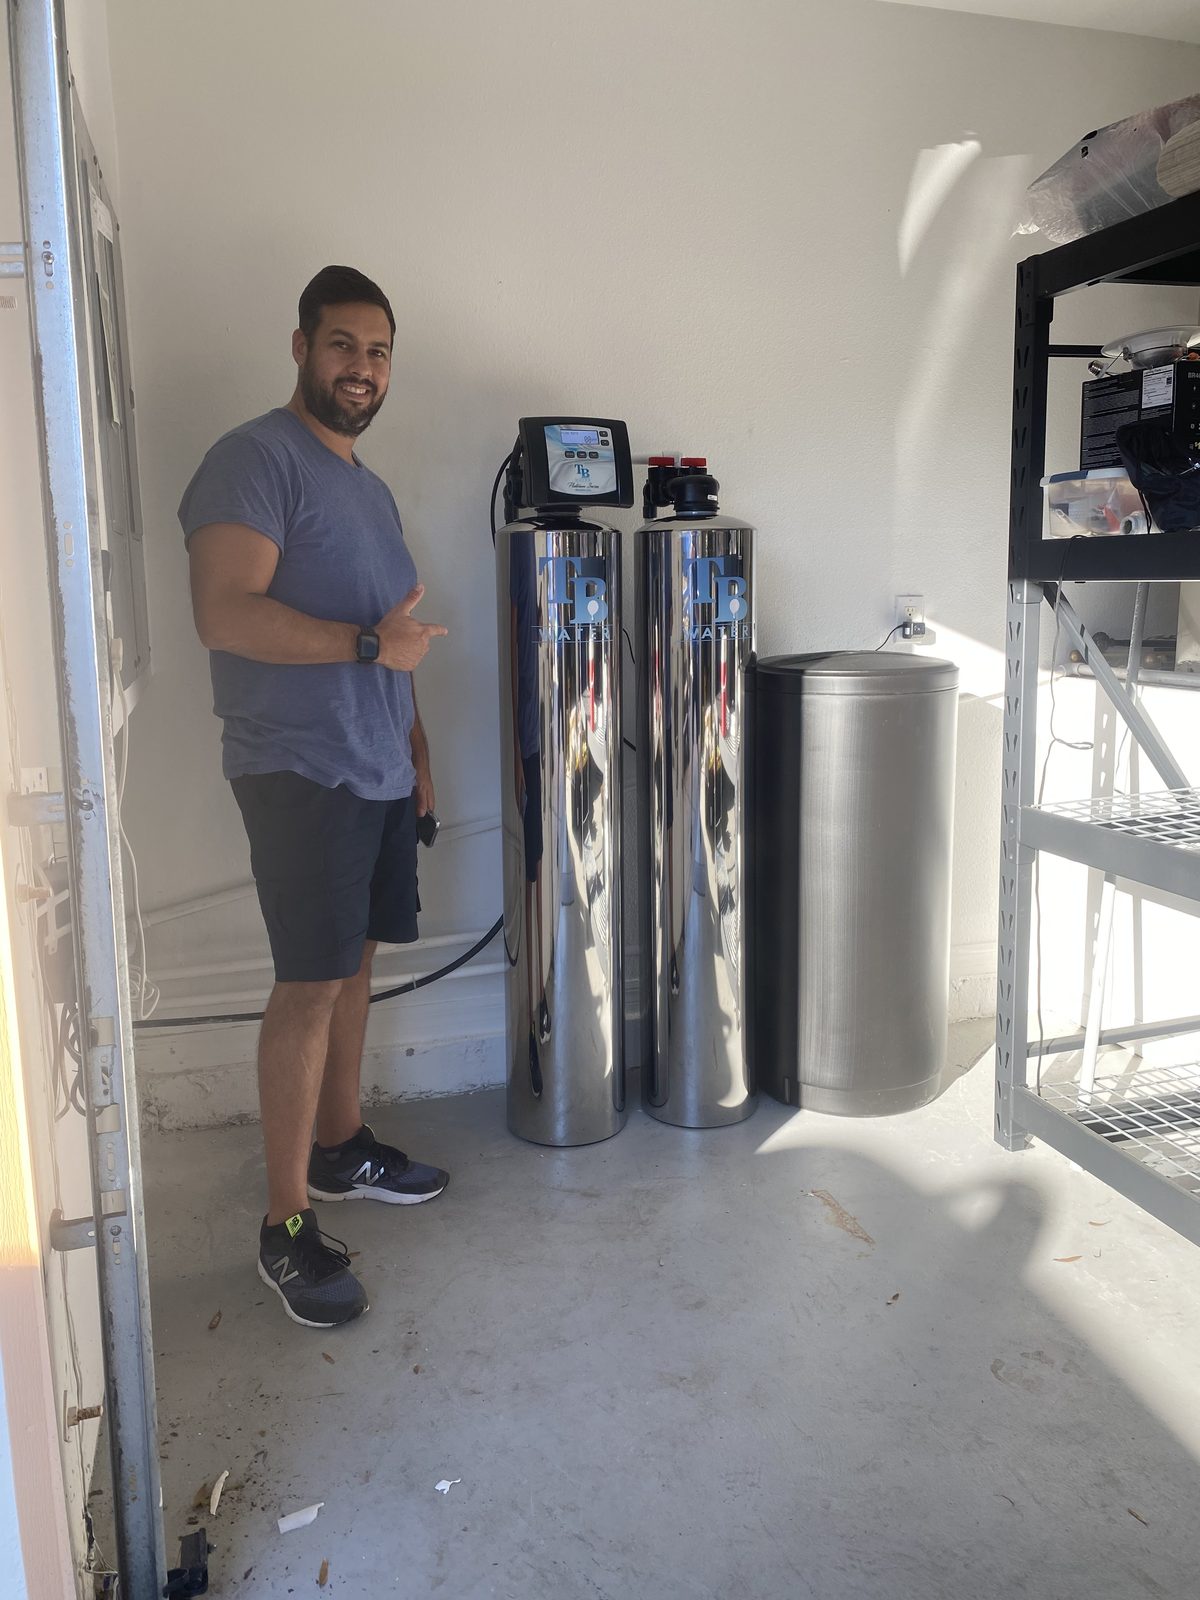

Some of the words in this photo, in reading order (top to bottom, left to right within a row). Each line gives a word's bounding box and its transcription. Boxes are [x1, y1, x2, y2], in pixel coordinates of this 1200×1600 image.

[574, 464, 590, 478] TB
[538, 556, 608, 625] TB
[683, 556, 748, 623] TB
[538, 626, 610, 641] WATER
[683, 625, 749, 640] WATER
